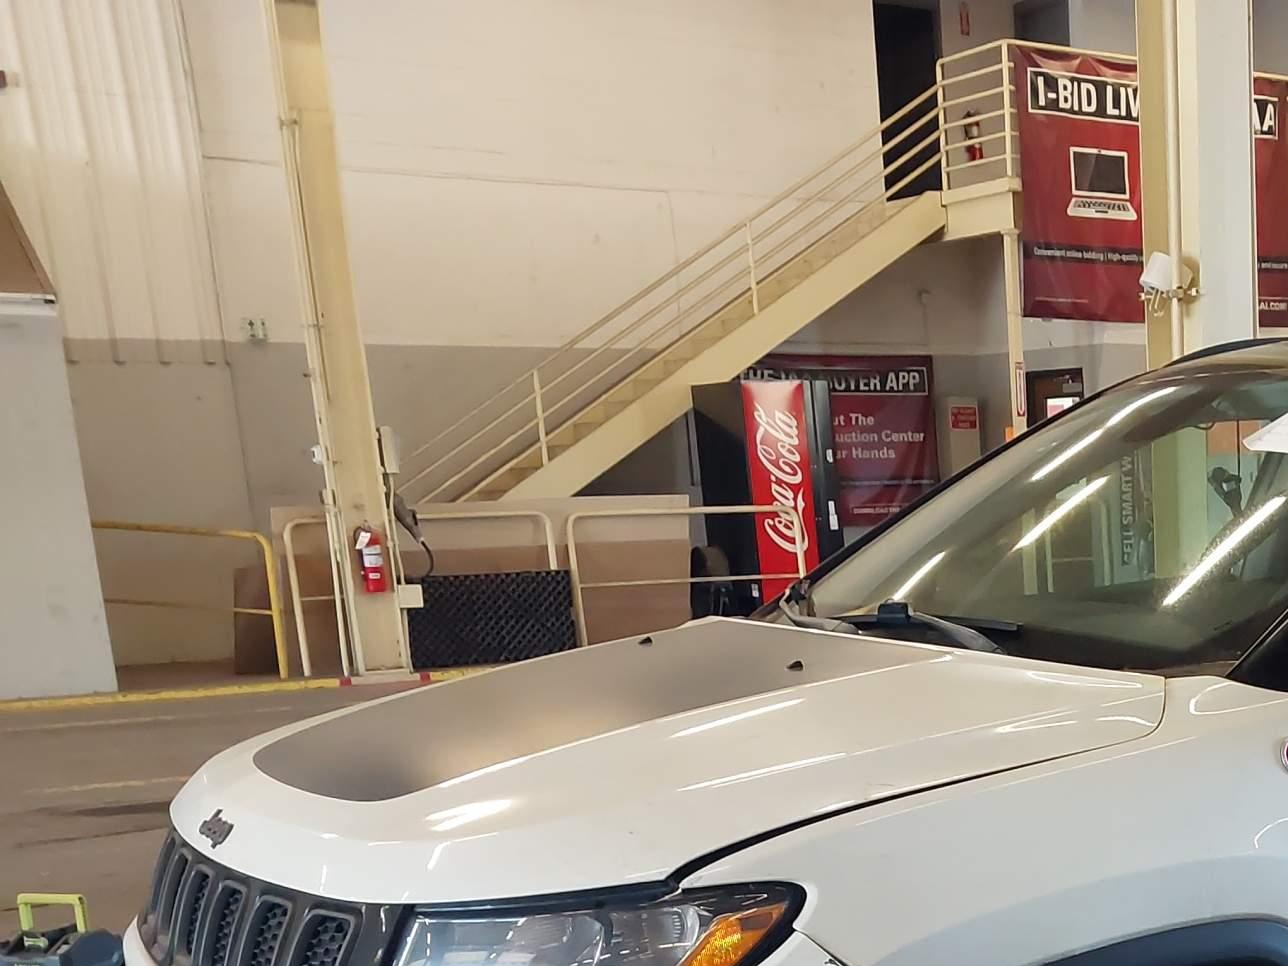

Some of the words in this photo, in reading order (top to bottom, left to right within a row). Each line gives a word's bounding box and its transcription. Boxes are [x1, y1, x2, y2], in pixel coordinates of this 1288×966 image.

[1037, 76, 1097, 113] I-BID
[886, 371, 920, 391] APP
[849, 413, 875, 426] The
[881, 430, 925, 442] Center
[852, 447, 896, 459] Hands
[1121, 474, 1134, 525] SMART
